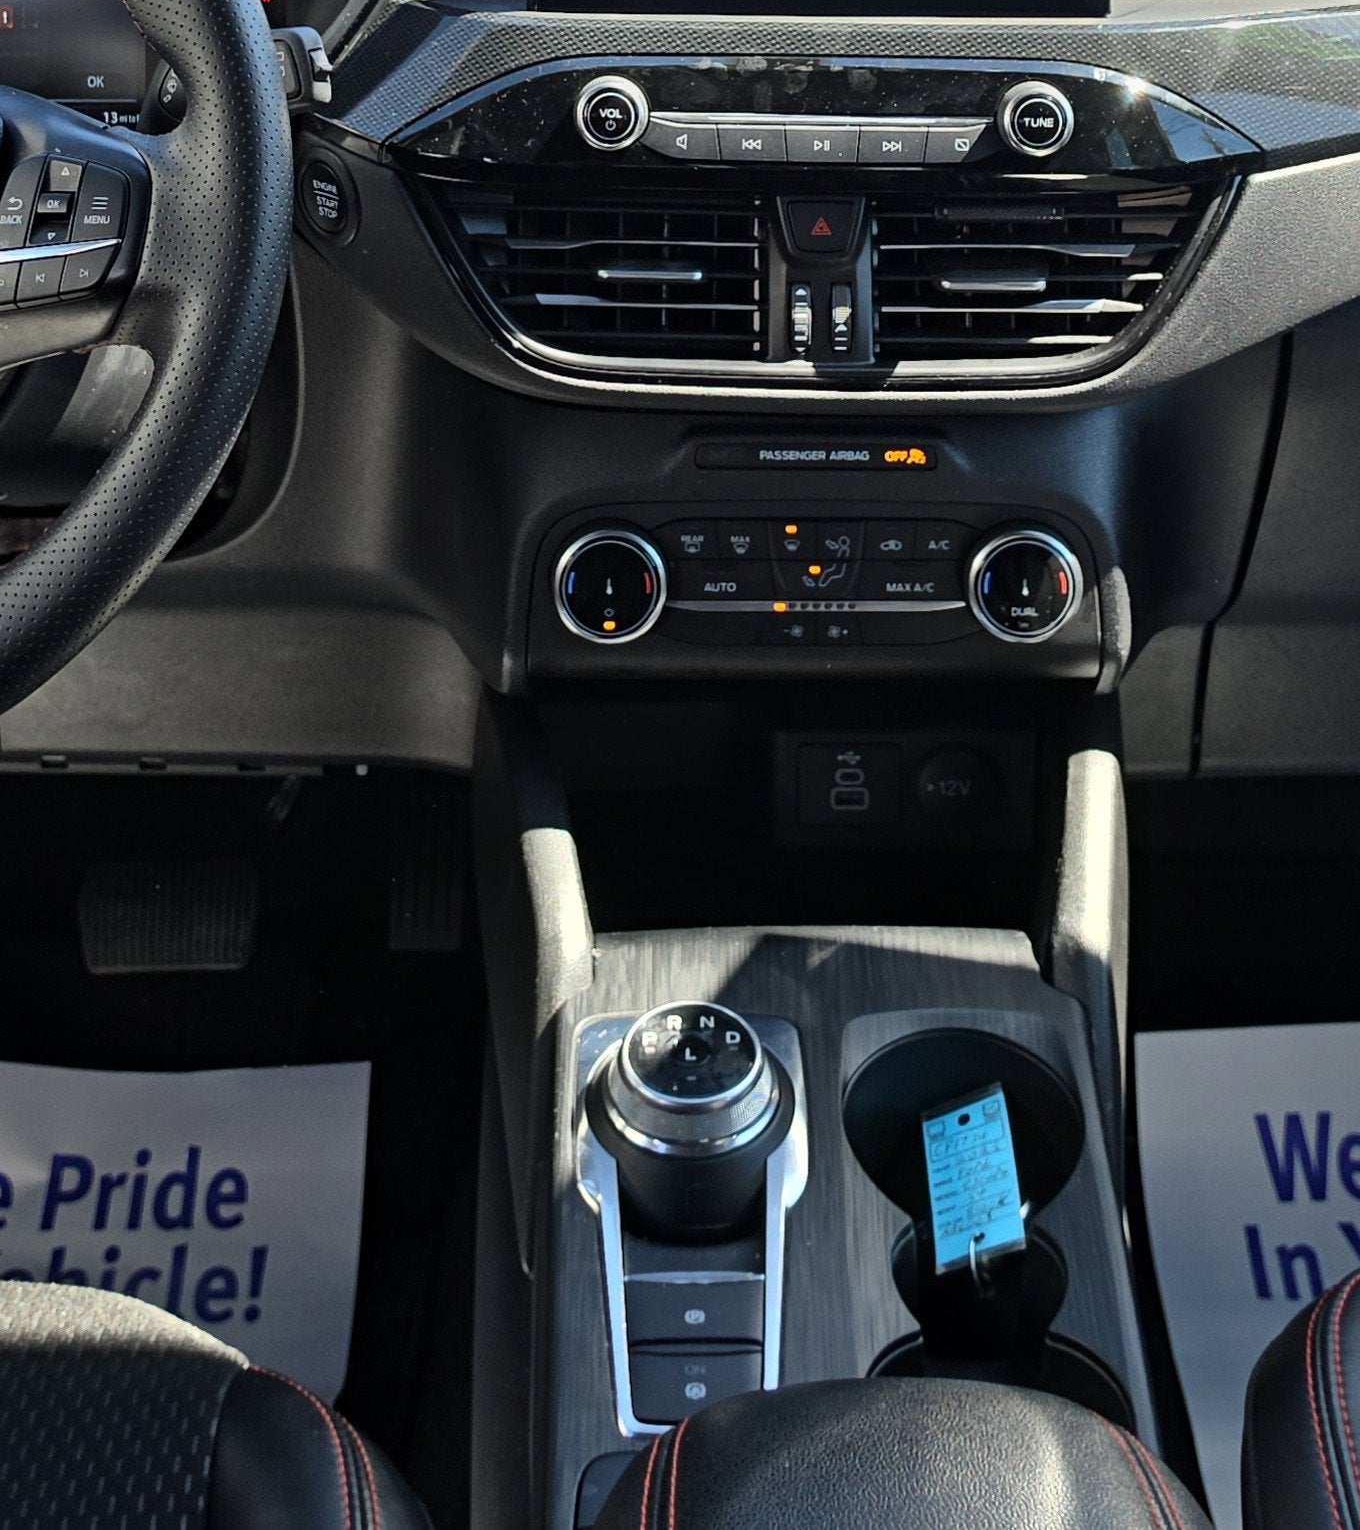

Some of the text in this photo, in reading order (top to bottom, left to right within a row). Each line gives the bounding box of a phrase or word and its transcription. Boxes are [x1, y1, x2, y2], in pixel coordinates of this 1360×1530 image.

[87, 75, 105, 89] OK
[103, 111, 118, 124] 13
[598, 108, 622, 120] VOL
[1024, 116, 1055, 128] TUNE
[46, 199, 60, 209] OK
[316, 195, 339, 210] START
[318, 206, 338, 219] STOP
[0, 214, 23, 225] BACK
[83, 215, 111, 224] MENU
[759, 450, 908, 463] PASSENGER AIRBAG OFF
[680, 534, 705, 544] REAR
[928, 538, 951, 552] A/C
[703, 581, 737, 594] AUTO
[885, 581, 935, 594] MAX A/C
[1010, 606, 1039, 617] DUAL
[936, 778, 973, 798] 12V
[667, 1015, 682, 1030] R
[700, 1015, 714, 1029] N
[641, 1030, 658, 1047] P
[726, 1030, 741, 1045] D
[685, 1046, 697, 1062] L
[41, 1145, 251, 1234] Pride
[1244, 1222, 1320, 1302] In
